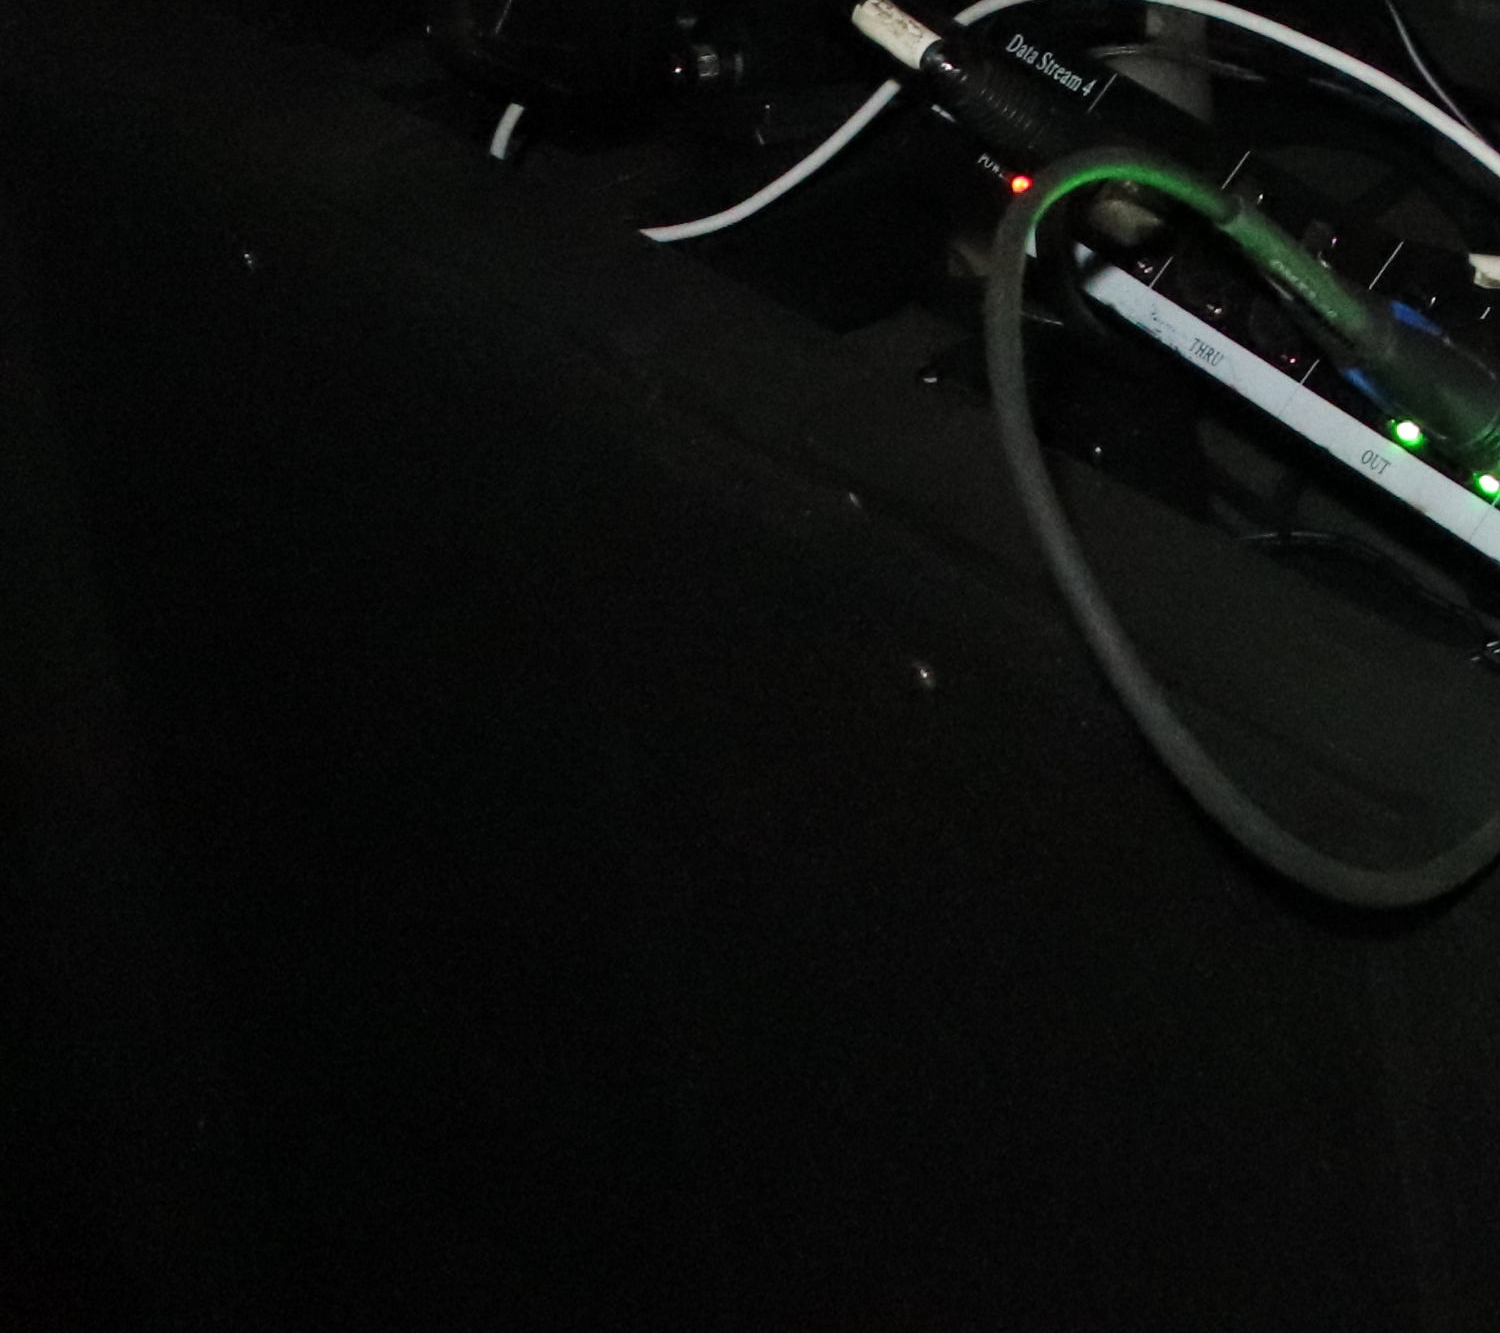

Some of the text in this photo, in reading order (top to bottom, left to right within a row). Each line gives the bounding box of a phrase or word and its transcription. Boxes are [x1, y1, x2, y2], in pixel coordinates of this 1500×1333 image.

[1005, 34, 1097, 97] Data Stream 4
[1188, 337, 1224, 367] THRU
[1361, 449, 1392, 475] OUT
